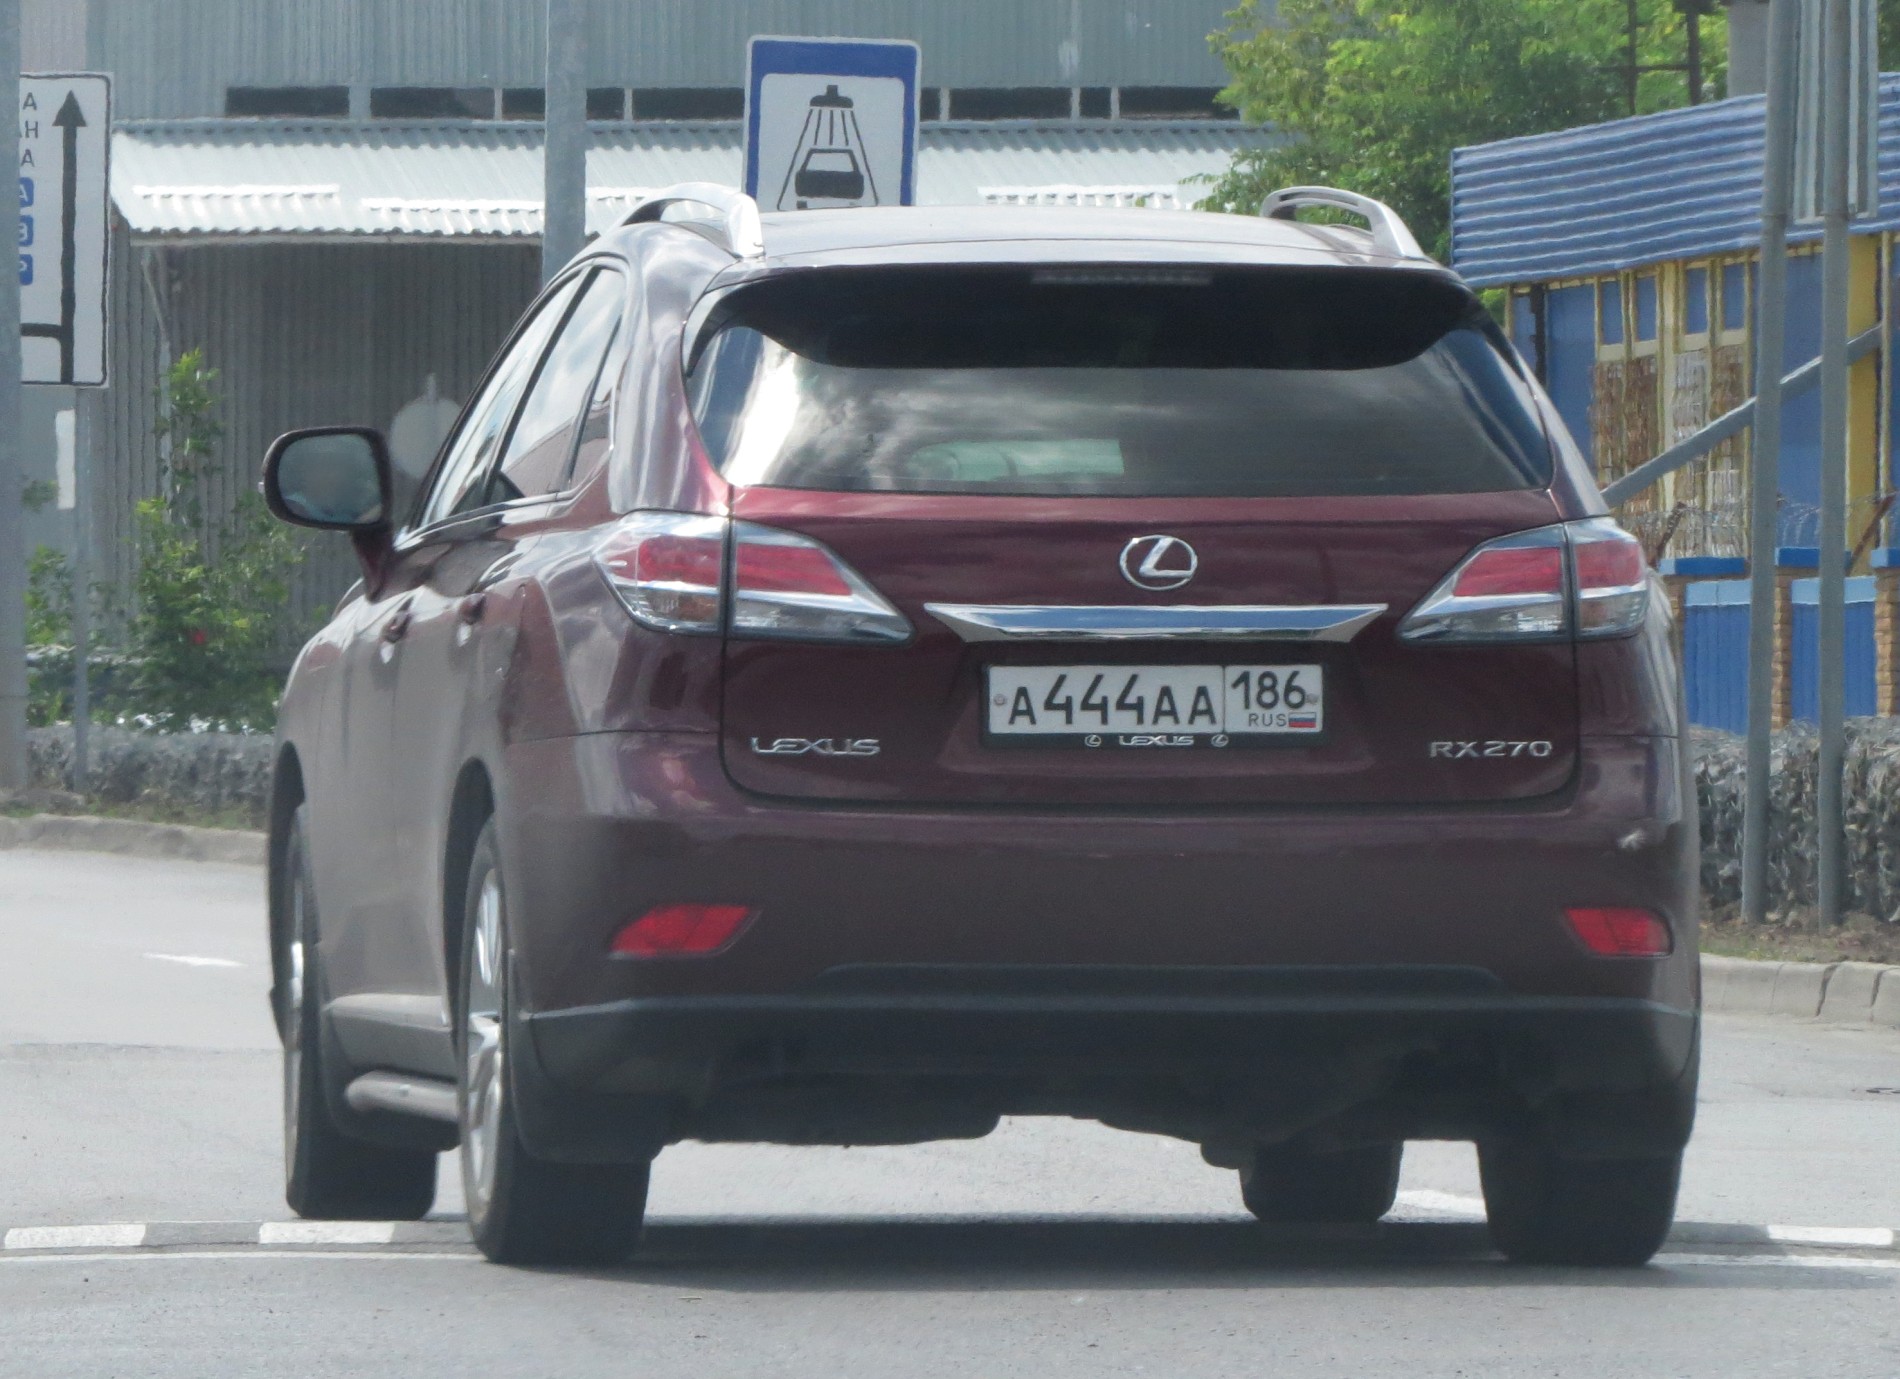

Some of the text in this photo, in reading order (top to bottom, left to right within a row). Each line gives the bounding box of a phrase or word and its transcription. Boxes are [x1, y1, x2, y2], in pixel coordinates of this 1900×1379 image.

[1231, 670, 1306, 710] 186
[1248, 712, 1287, 727] RUS
[751, 736, 881, 756] LEXUS
[1118, 735, 1195, 747] LEXUS
